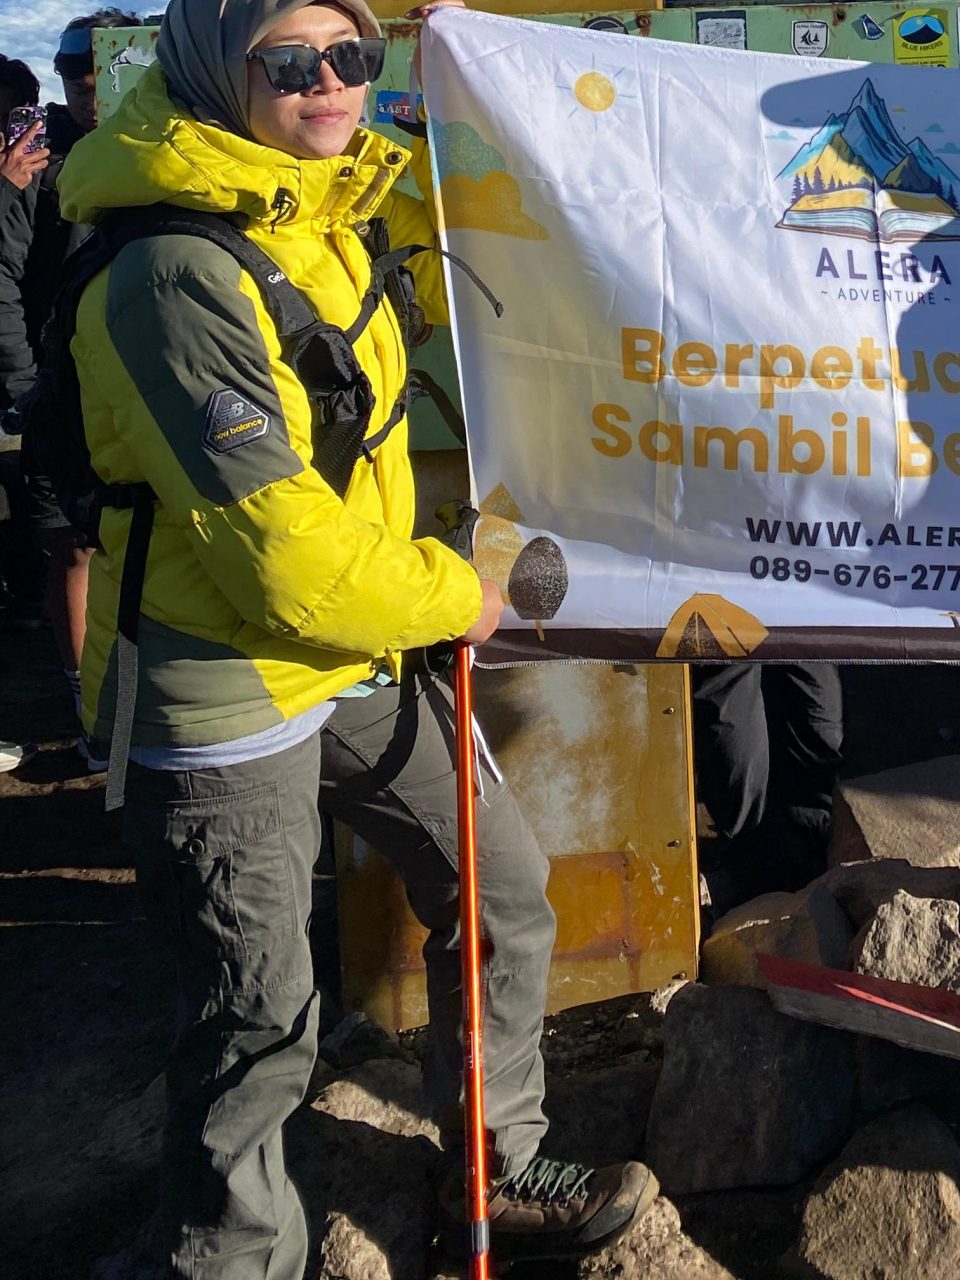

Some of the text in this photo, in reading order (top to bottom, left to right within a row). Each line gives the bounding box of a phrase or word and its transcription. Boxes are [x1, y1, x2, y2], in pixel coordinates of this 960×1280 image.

[901, 39, 943, 51] BLUE HIKERS
[815, 247, 952, 285] ALERA
[837, 288, 937, 305] ADVENTURE
[229, 418, 263, 435] balance
[591, 402, 872, 478] Sambil
